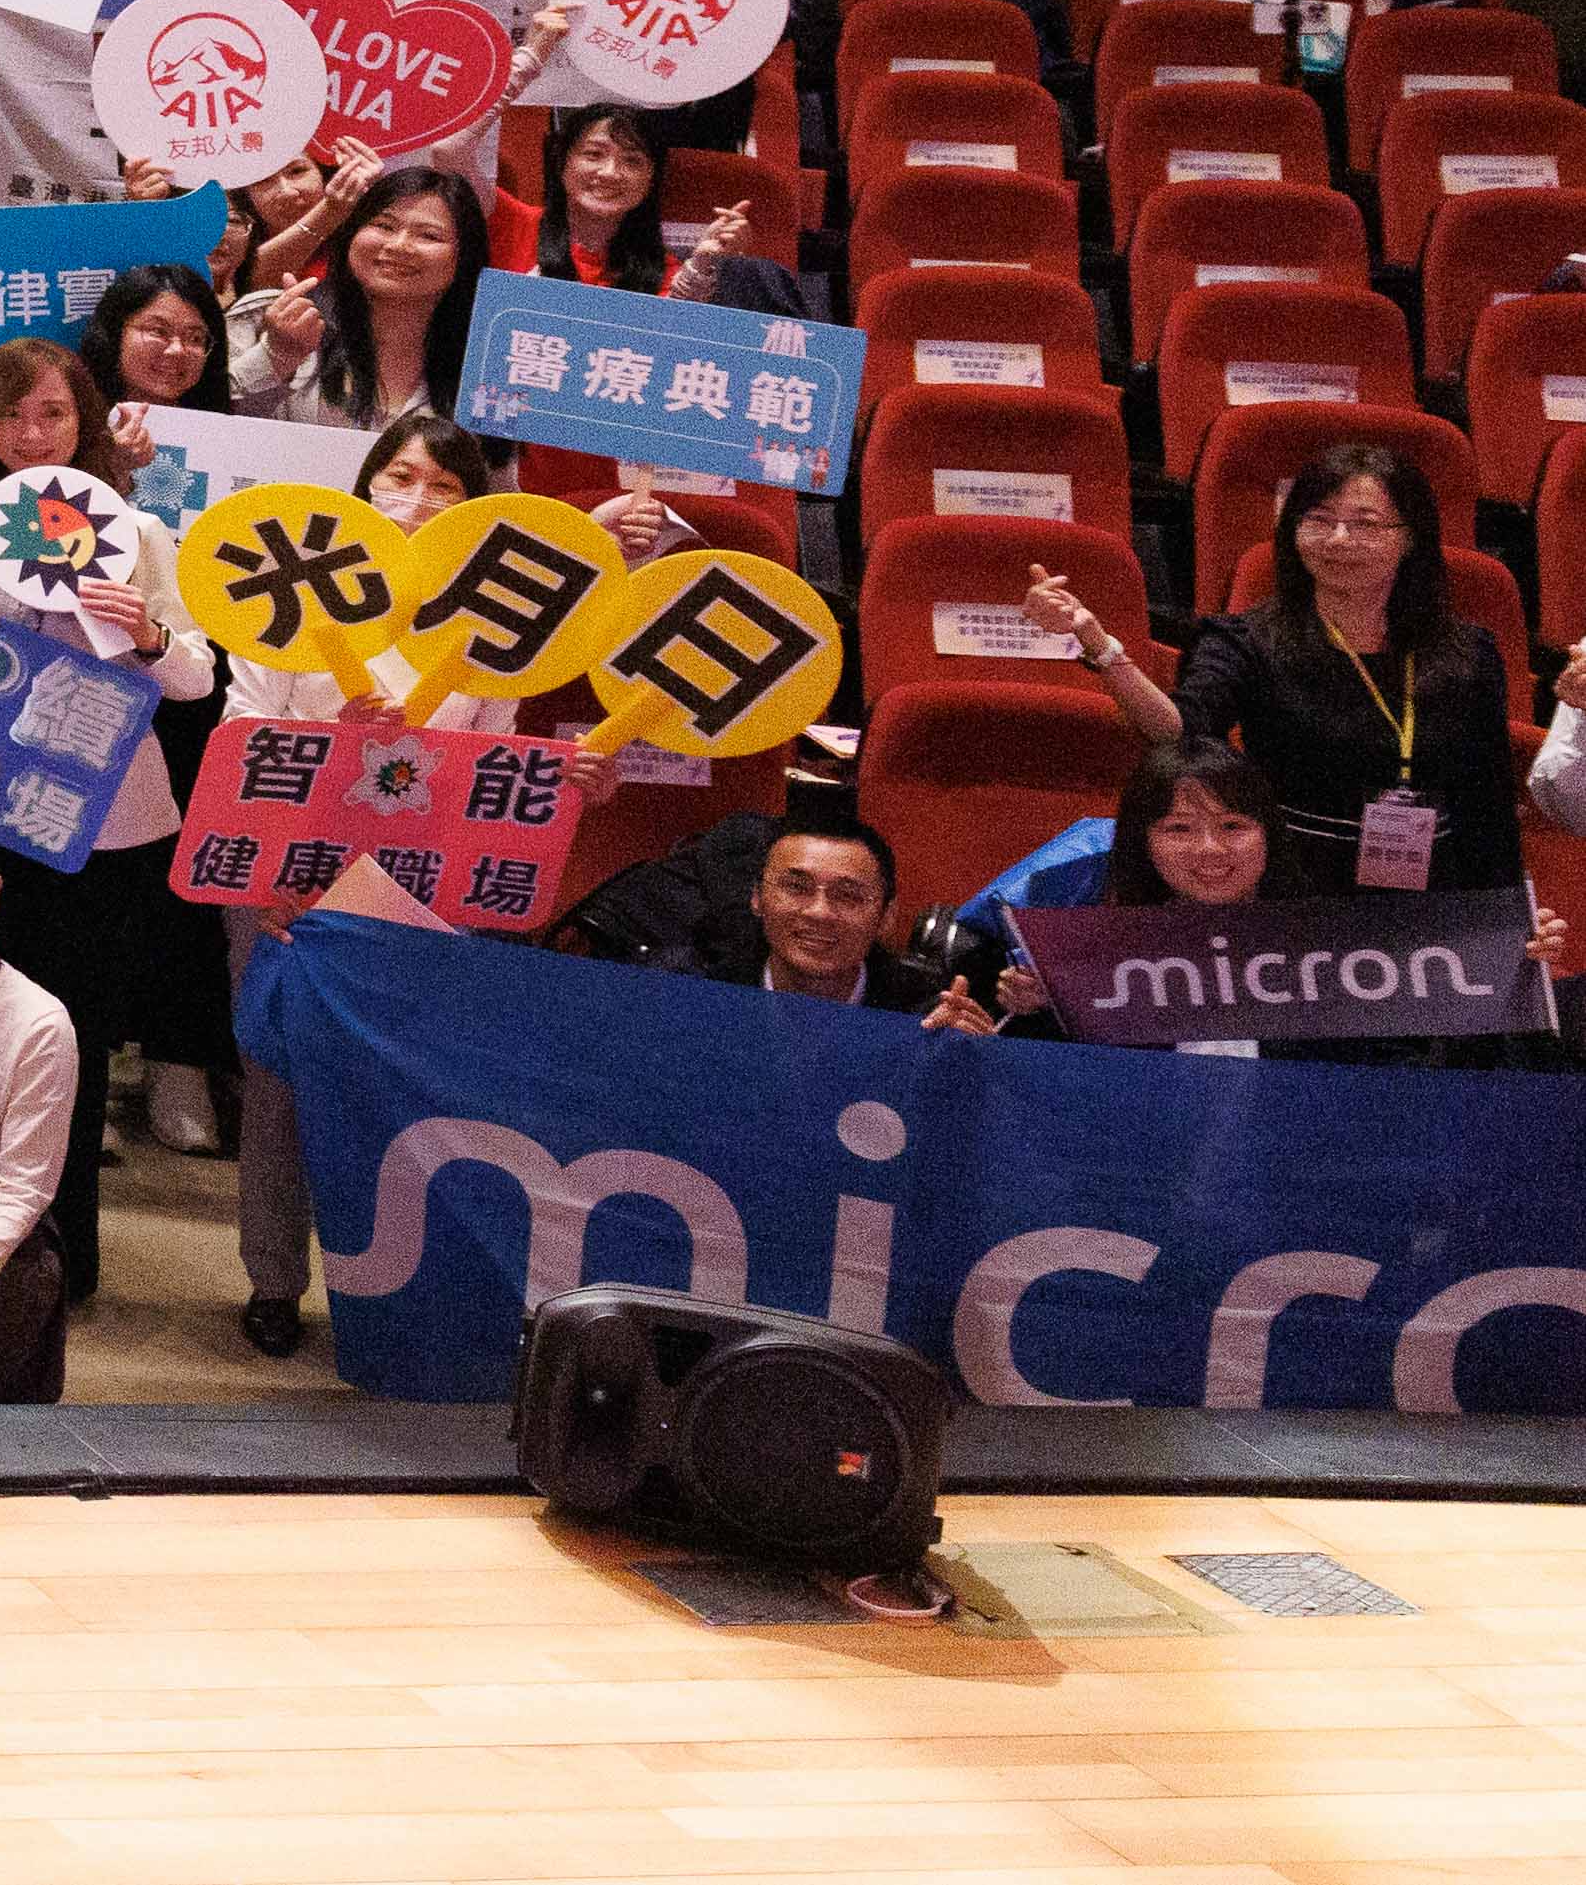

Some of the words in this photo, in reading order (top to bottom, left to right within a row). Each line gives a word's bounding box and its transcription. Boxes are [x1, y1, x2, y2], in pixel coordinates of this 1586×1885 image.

[325, 19, 462, 96] LOVE
[160, 86, 263, 128] AIA
[167, 131, 263, 158] 友邦人壽
[507, 330, 820, 435] 醫療典範
[1095, 935, 1493, 1012] micron
